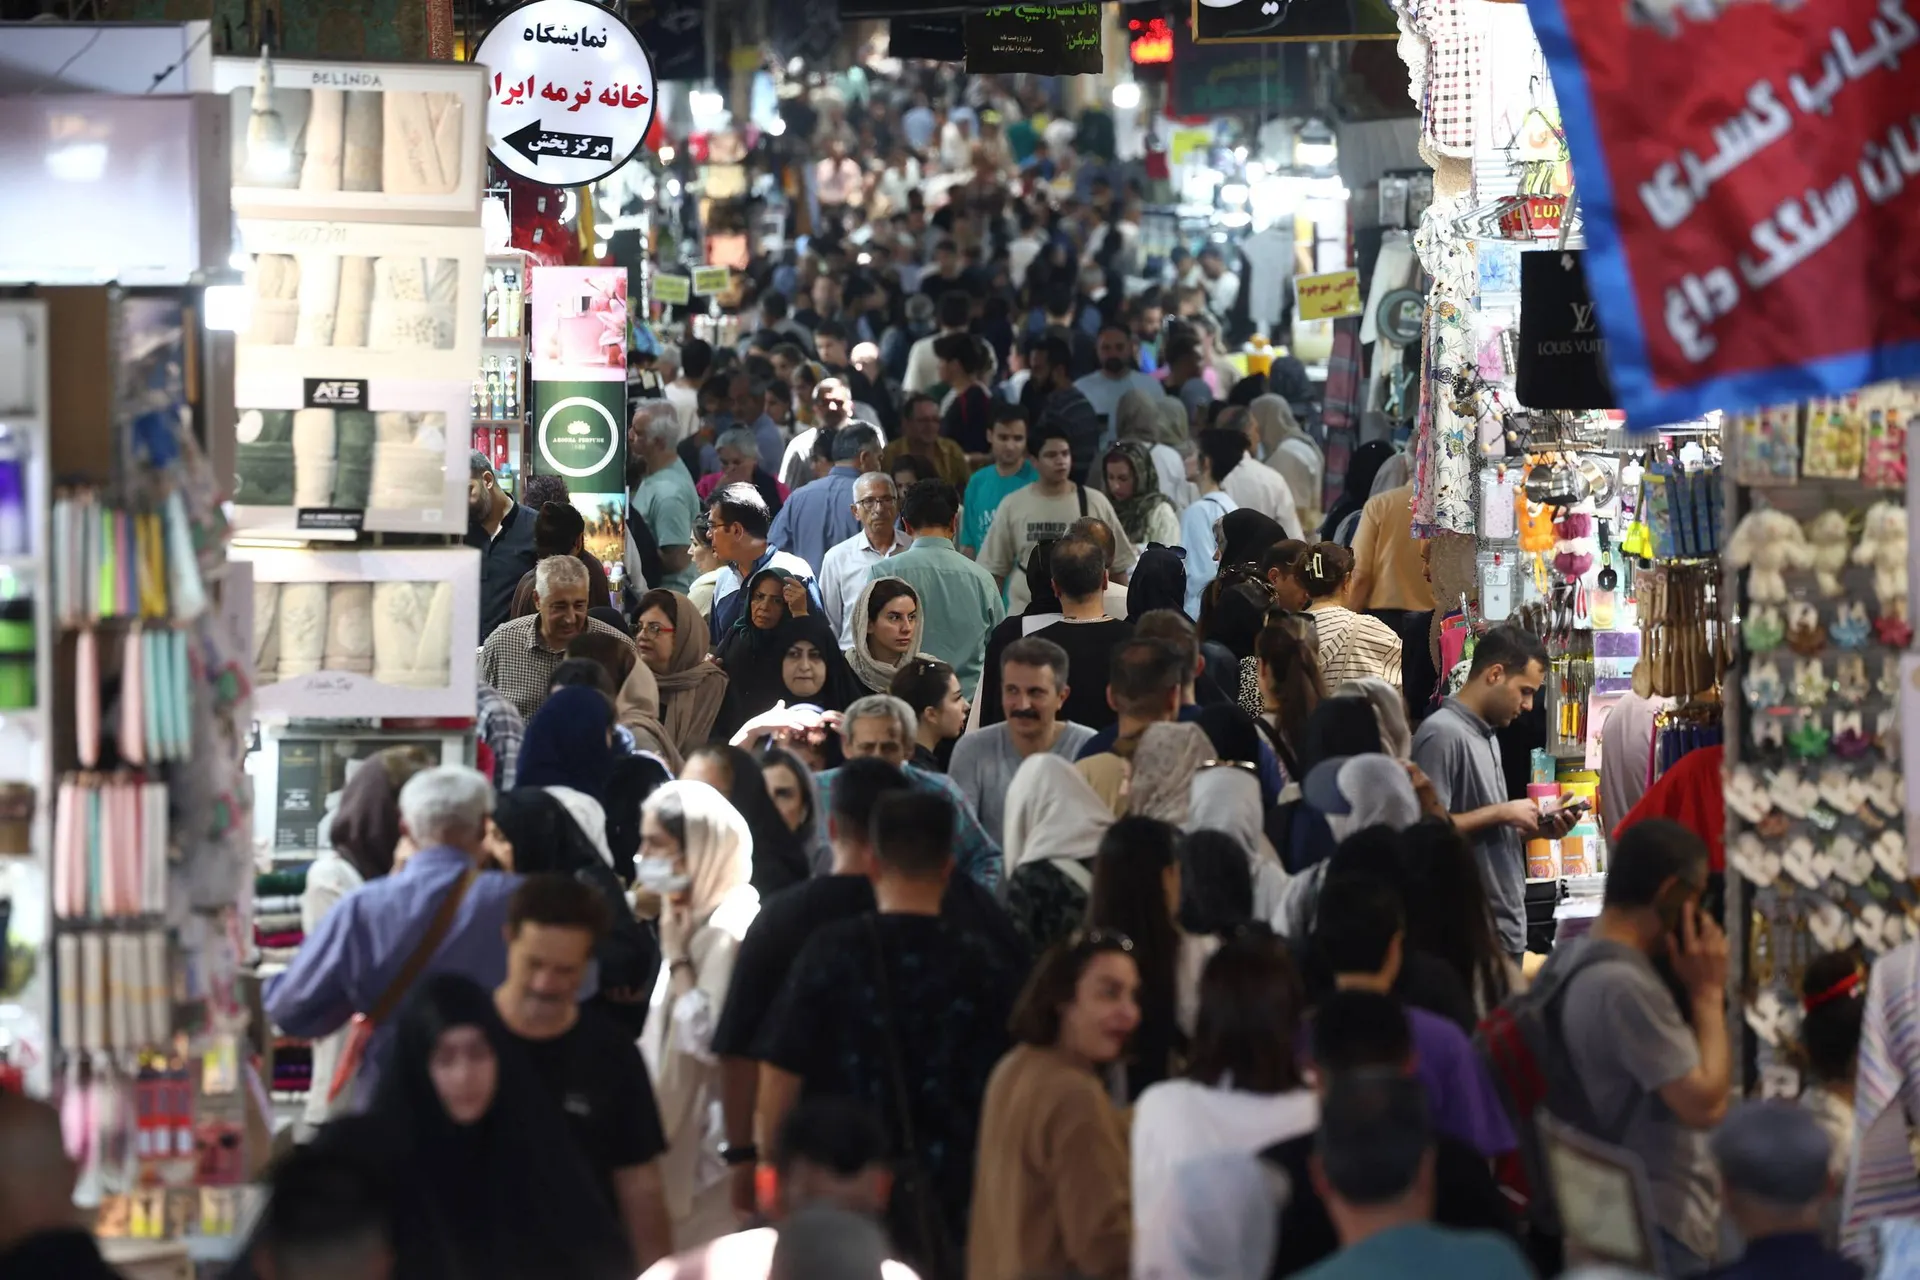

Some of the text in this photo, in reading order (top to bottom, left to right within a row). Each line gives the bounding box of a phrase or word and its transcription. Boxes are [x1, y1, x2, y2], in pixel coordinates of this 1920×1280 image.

[523, 23, 608, 52] نمایشگاه
[1789, 0, 1920, 116] کباب
[312, 72, 383, 86] BELINDA
[541, 80, 593, 112] ترمه
[598, 82, 649, 109] خانه
[528, 133, 609, 157] مرکز پخش
[1534, 204, 1561, 219] LUX
[1664, 266, 1740, 363] داغ
[1538, 339, 1573, 356] LOUIS
[313, 381, 360, 399] ATS
